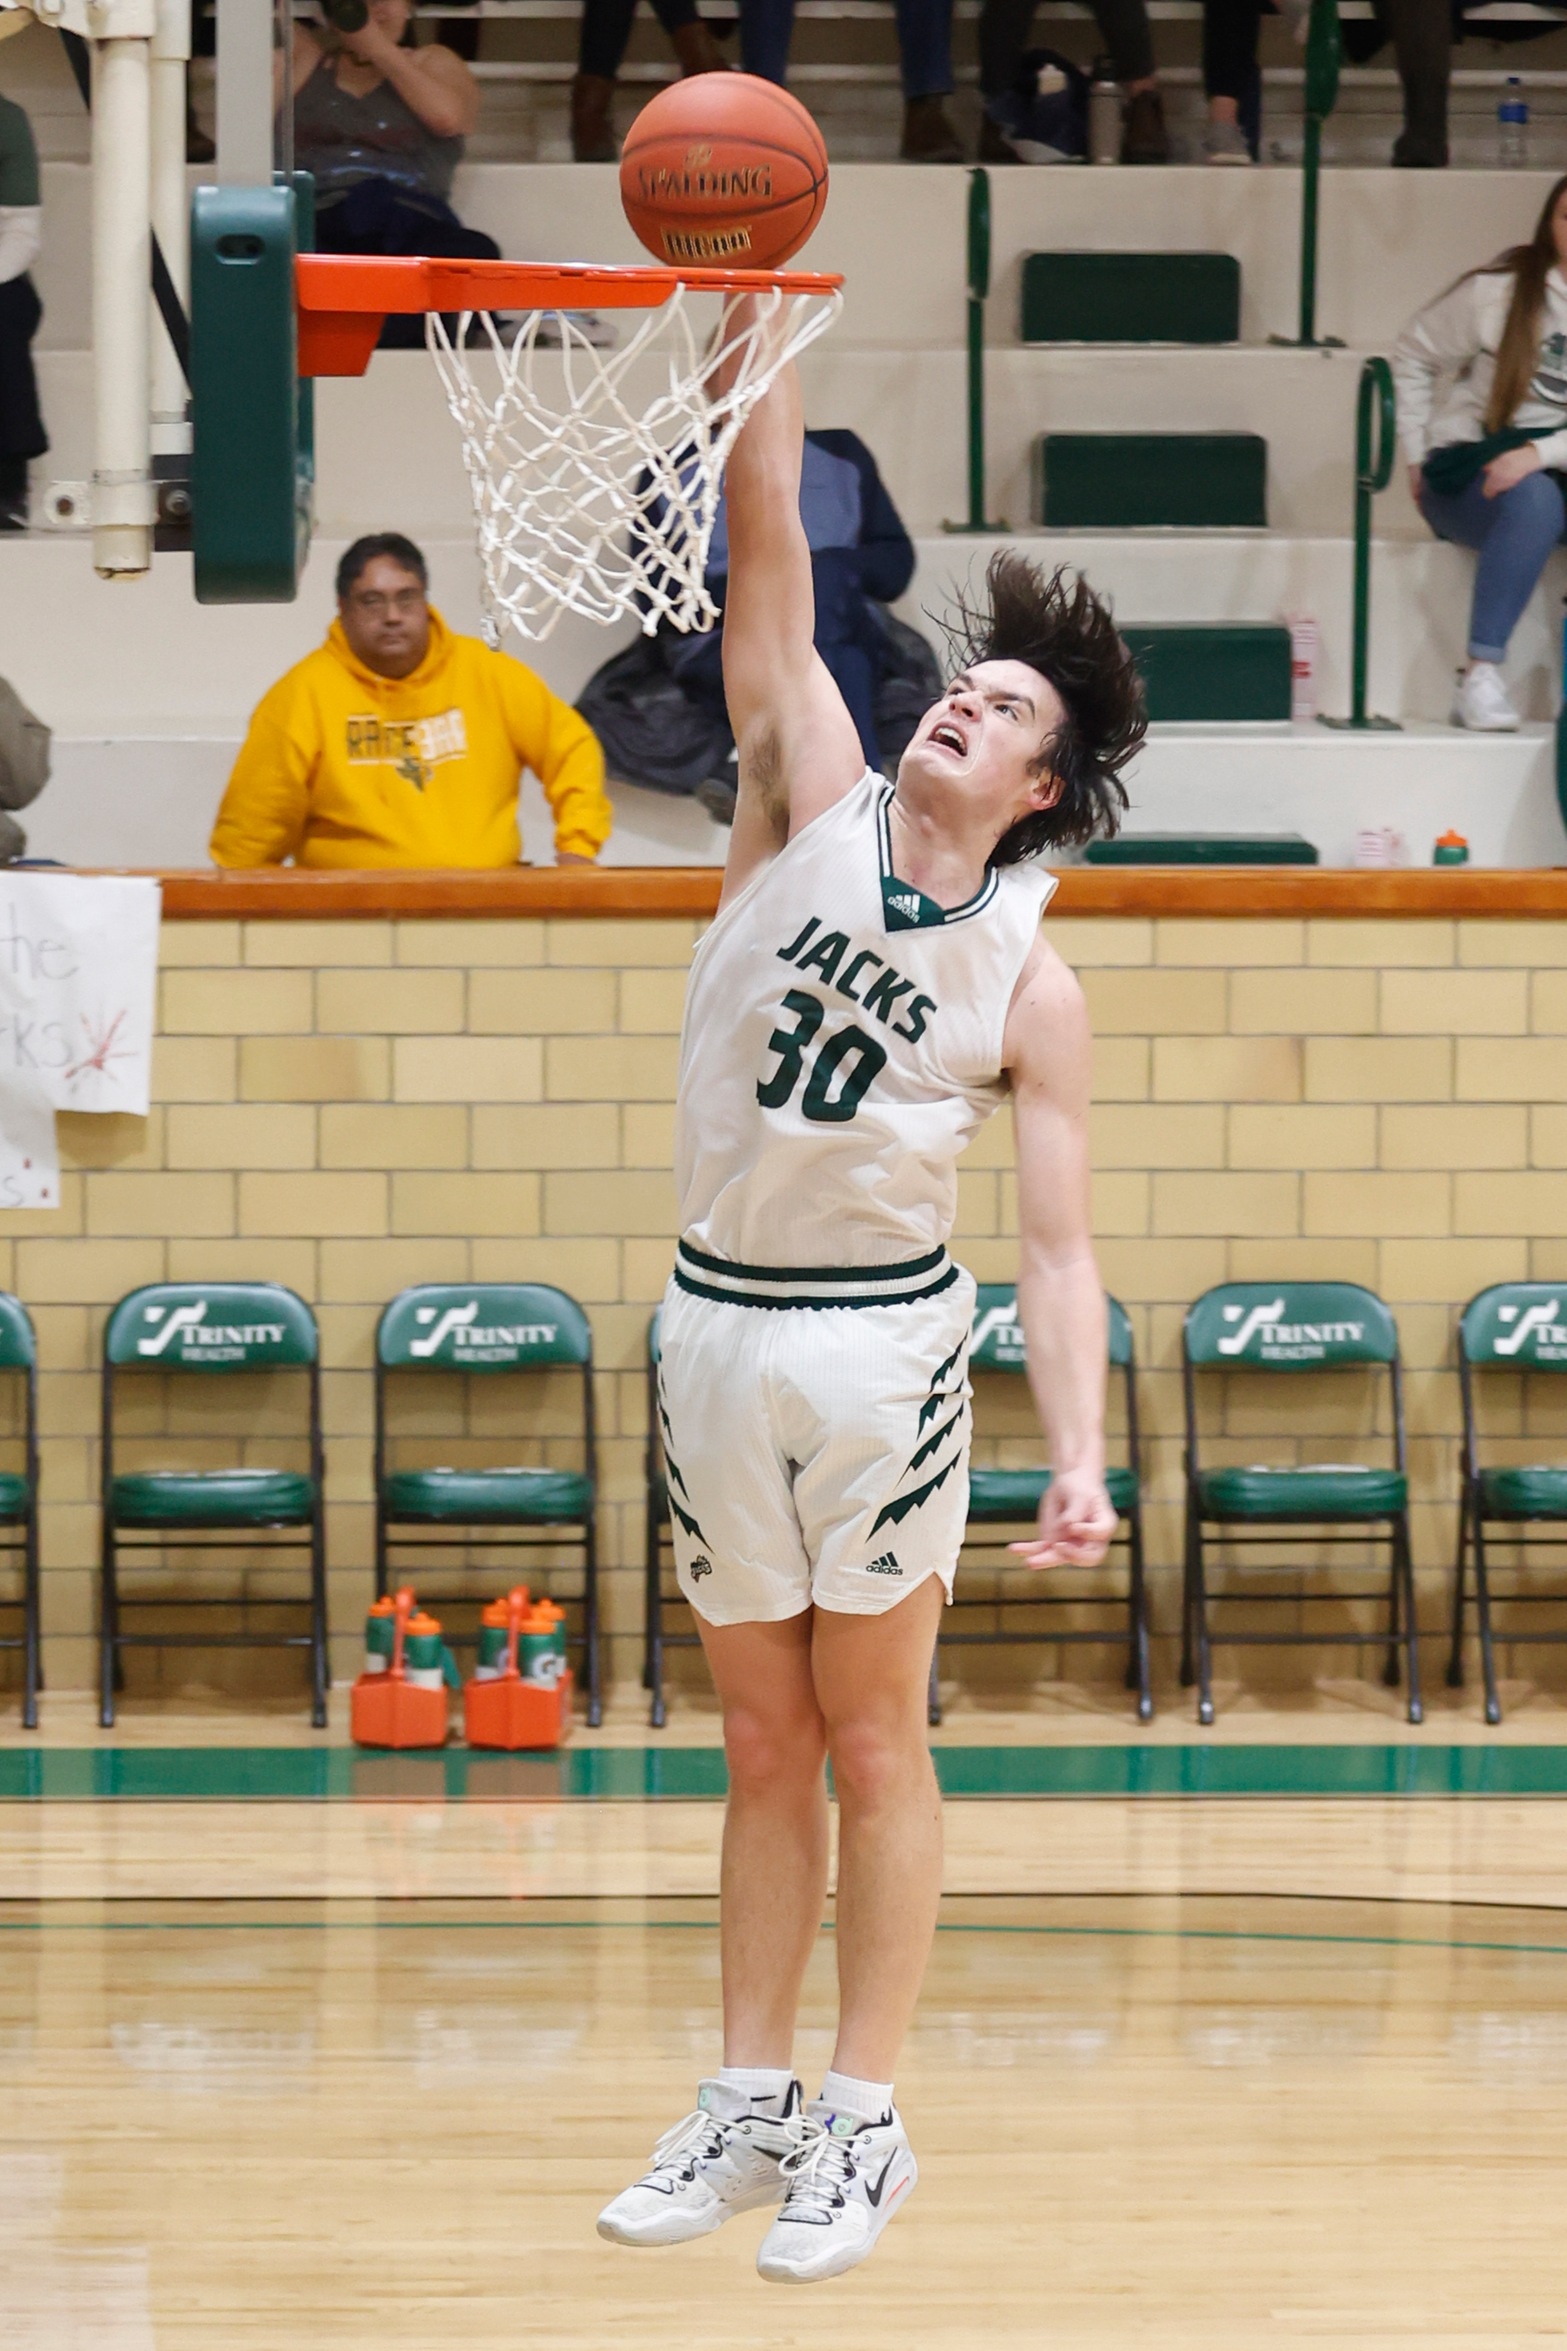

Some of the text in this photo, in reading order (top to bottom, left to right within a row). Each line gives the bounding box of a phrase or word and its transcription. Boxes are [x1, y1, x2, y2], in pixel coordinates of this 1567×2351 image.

[638, 163, 772, 200] SPALDING
[887, 896, 920, 923] adidas
[776, 916, 938, 1044] JACKS
[756, 988, 888, 1122] 30
[179, 1324, 286, 1345] TRINITY
[451, 1324, 558, 1346] TRINITY
[1258, 1321, 1364, 1343] TRINITY
